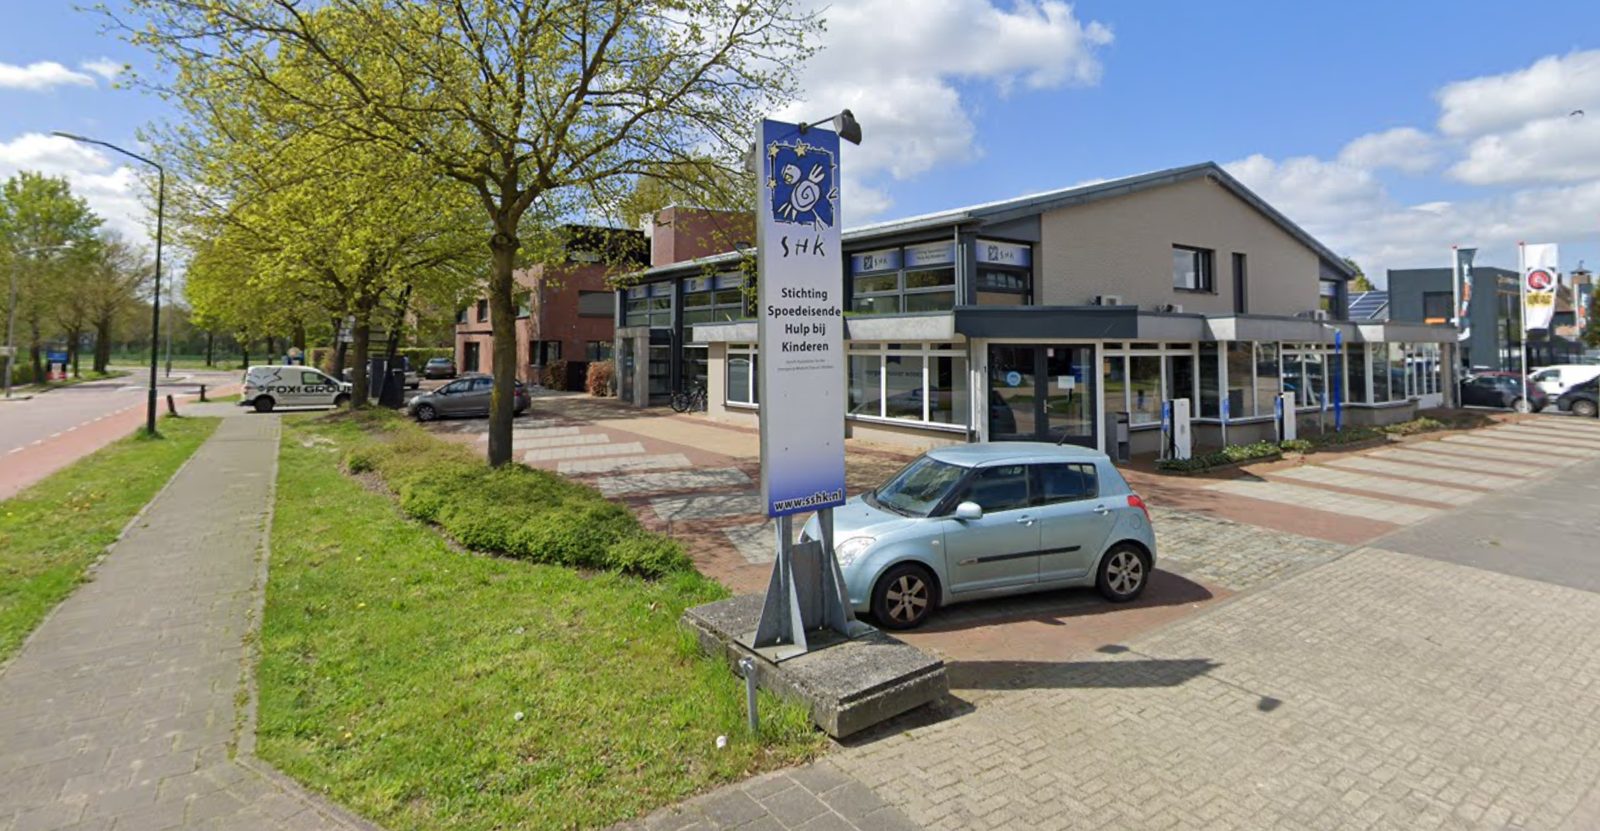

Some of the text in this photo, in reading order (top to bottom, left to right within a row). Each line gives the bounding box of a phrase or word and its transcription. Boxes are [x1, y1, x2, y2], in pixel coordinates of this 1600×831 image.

[781, 234, 825, 258] SHK
[781, 287, 828, 302] Stichting
[767, 305, 841, 319] Spoedeisende
[785, 322, 826, 336] Hulp bij
[781, 341, 829, 352] Kinderen
[774, 488, 842, 511] www.sshk.nl
